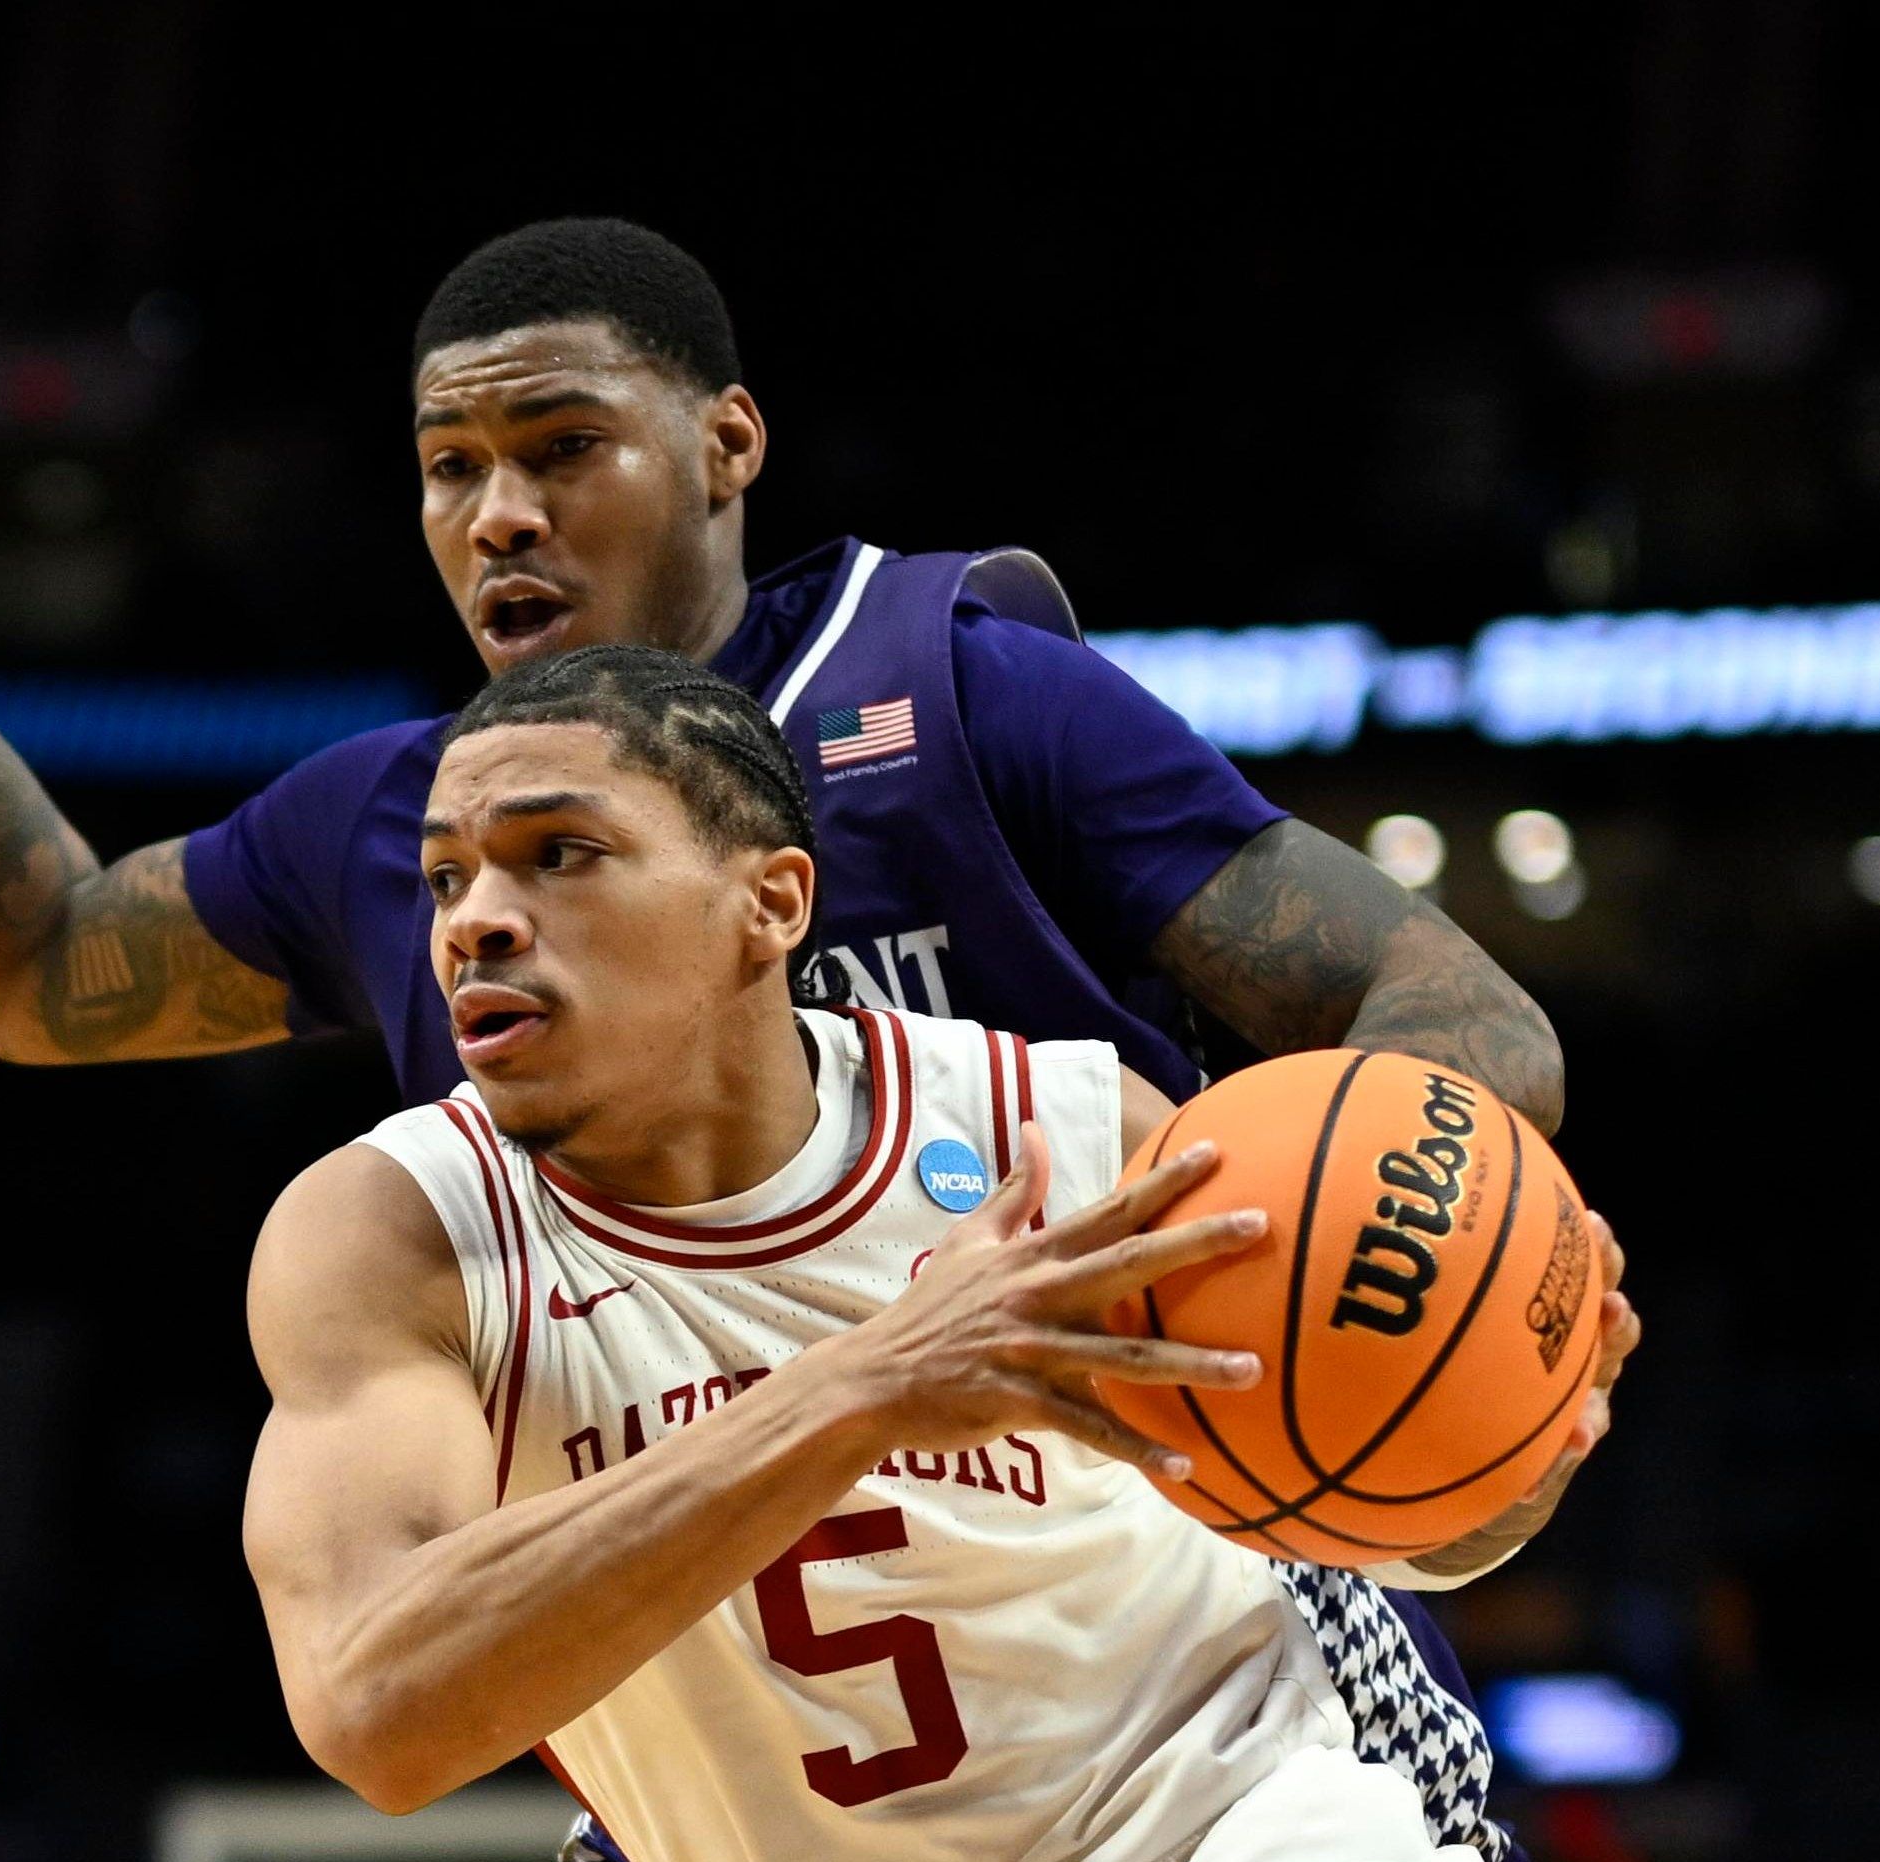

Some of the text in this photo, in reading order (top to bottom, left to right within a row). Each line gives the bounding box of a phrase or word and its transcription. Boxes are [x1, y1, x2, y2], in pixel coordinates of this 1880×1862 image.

[929, 1171, 986, 1194] NCAA
[1330, 1073, 1476, 1336] Wilson
[753, 1506, 969, 1808] 5
